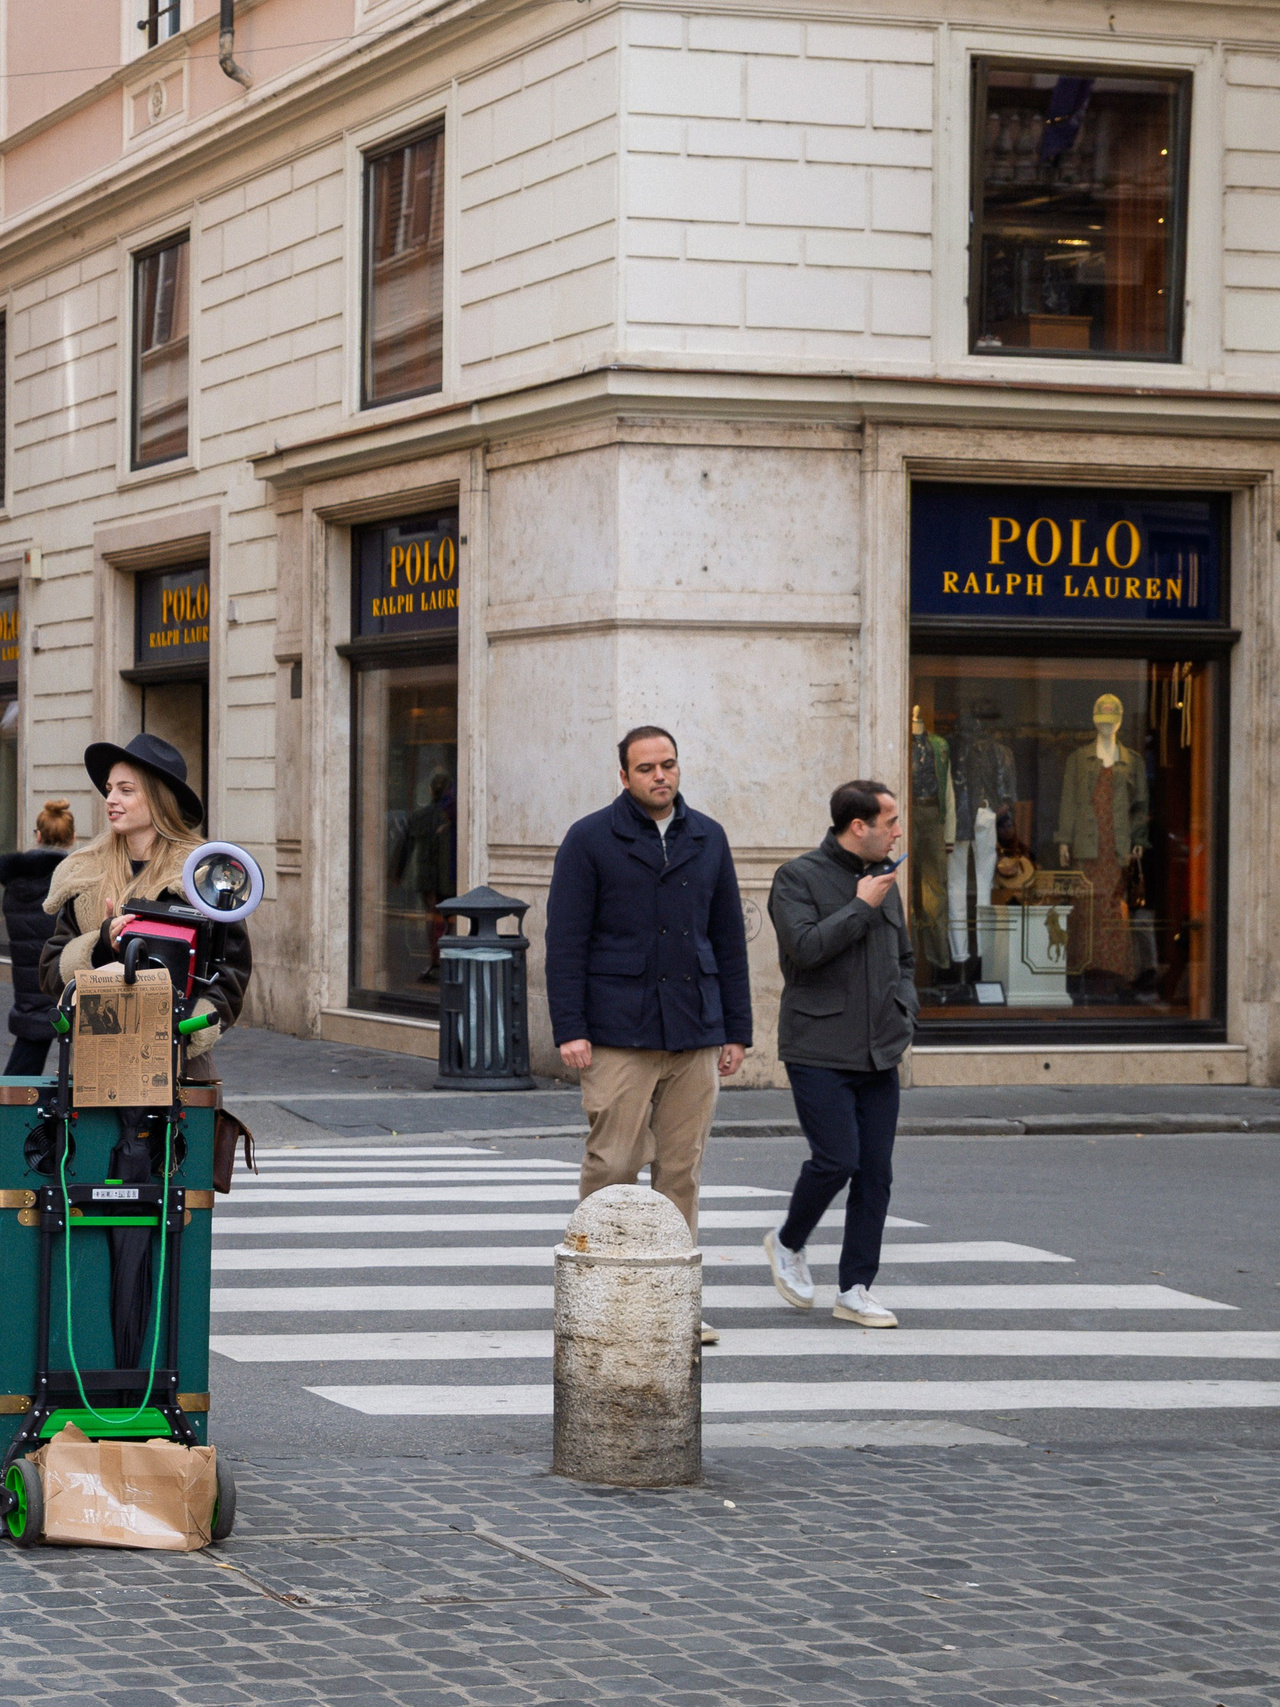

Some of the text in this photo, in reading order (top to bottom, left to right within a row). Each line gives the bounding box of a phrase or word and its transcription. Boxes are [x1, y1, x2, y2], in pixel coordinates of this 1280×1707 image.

[988, 516, 1142, 569] POLO
[390, 536, 455, 588] POLO
[942, 571, 1183, 601] RALPH LAUREN
[162, 582, 209, 624] POLO
[372, 593, 414, 617] RALPH
[149, 628, 180, 649] RALPH
[89, 974, 113, 984] Rome
